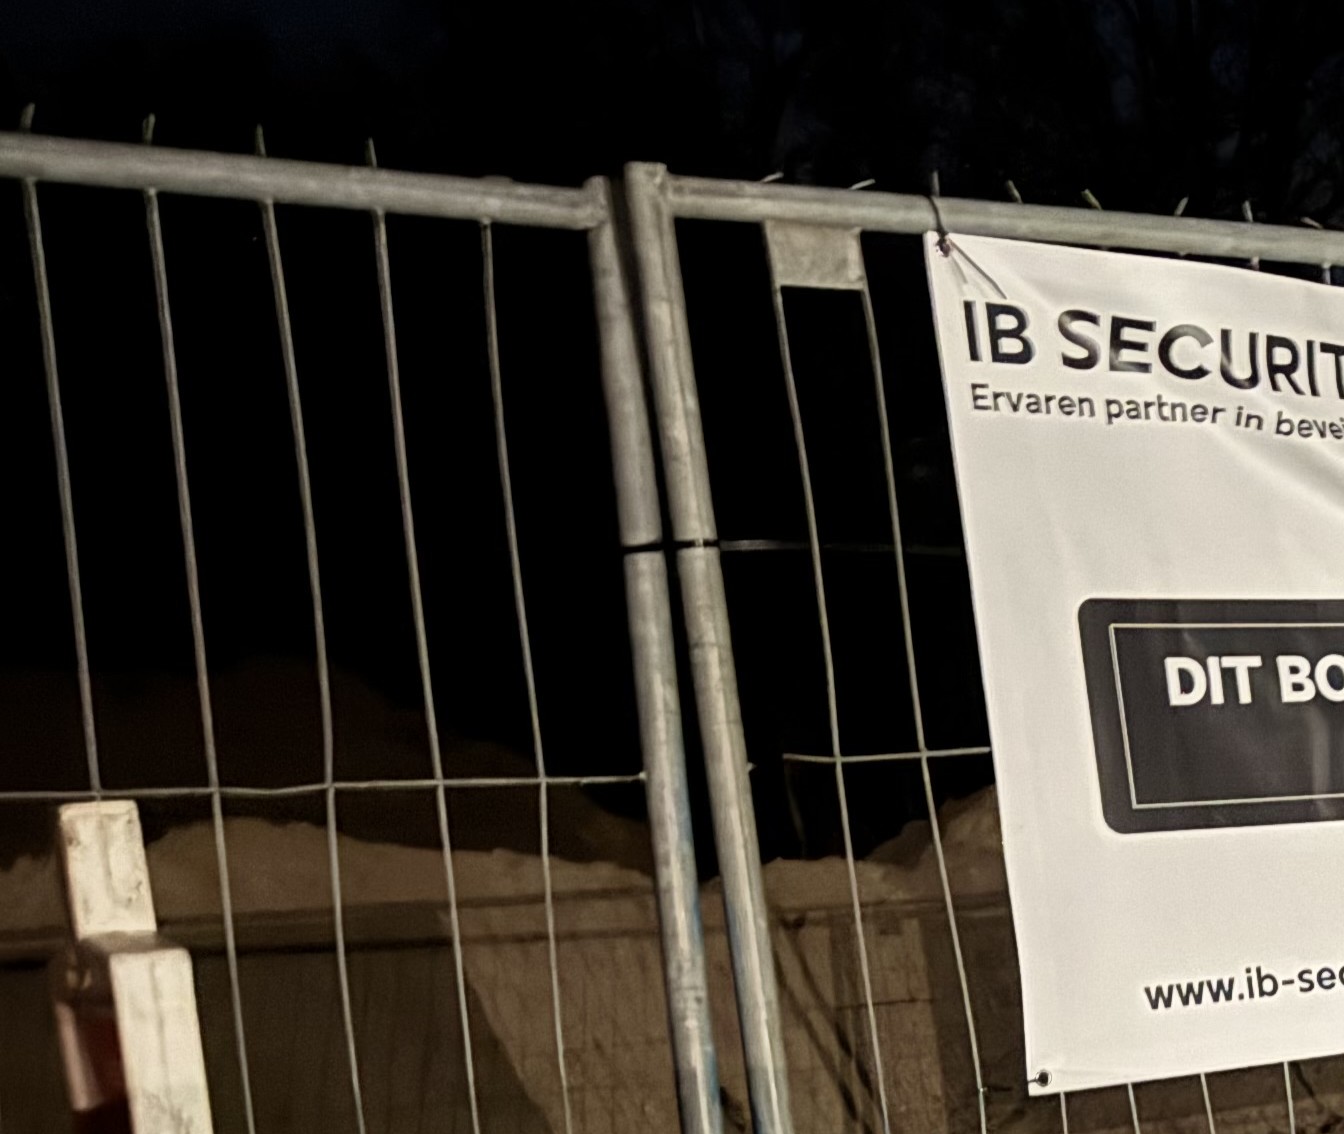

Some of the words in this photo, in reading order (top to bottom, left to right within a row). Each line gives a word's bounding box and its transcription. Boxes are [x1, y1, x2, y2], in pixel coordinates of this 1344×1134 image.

[963, 300, 1034, 365] IB
[970, 382, 1096, 418] Ervaren
[1105, 394, 1227, 426] partner
[1235, 405, 1264, 431] in
[1164, 655, 1263, 706] DIT
